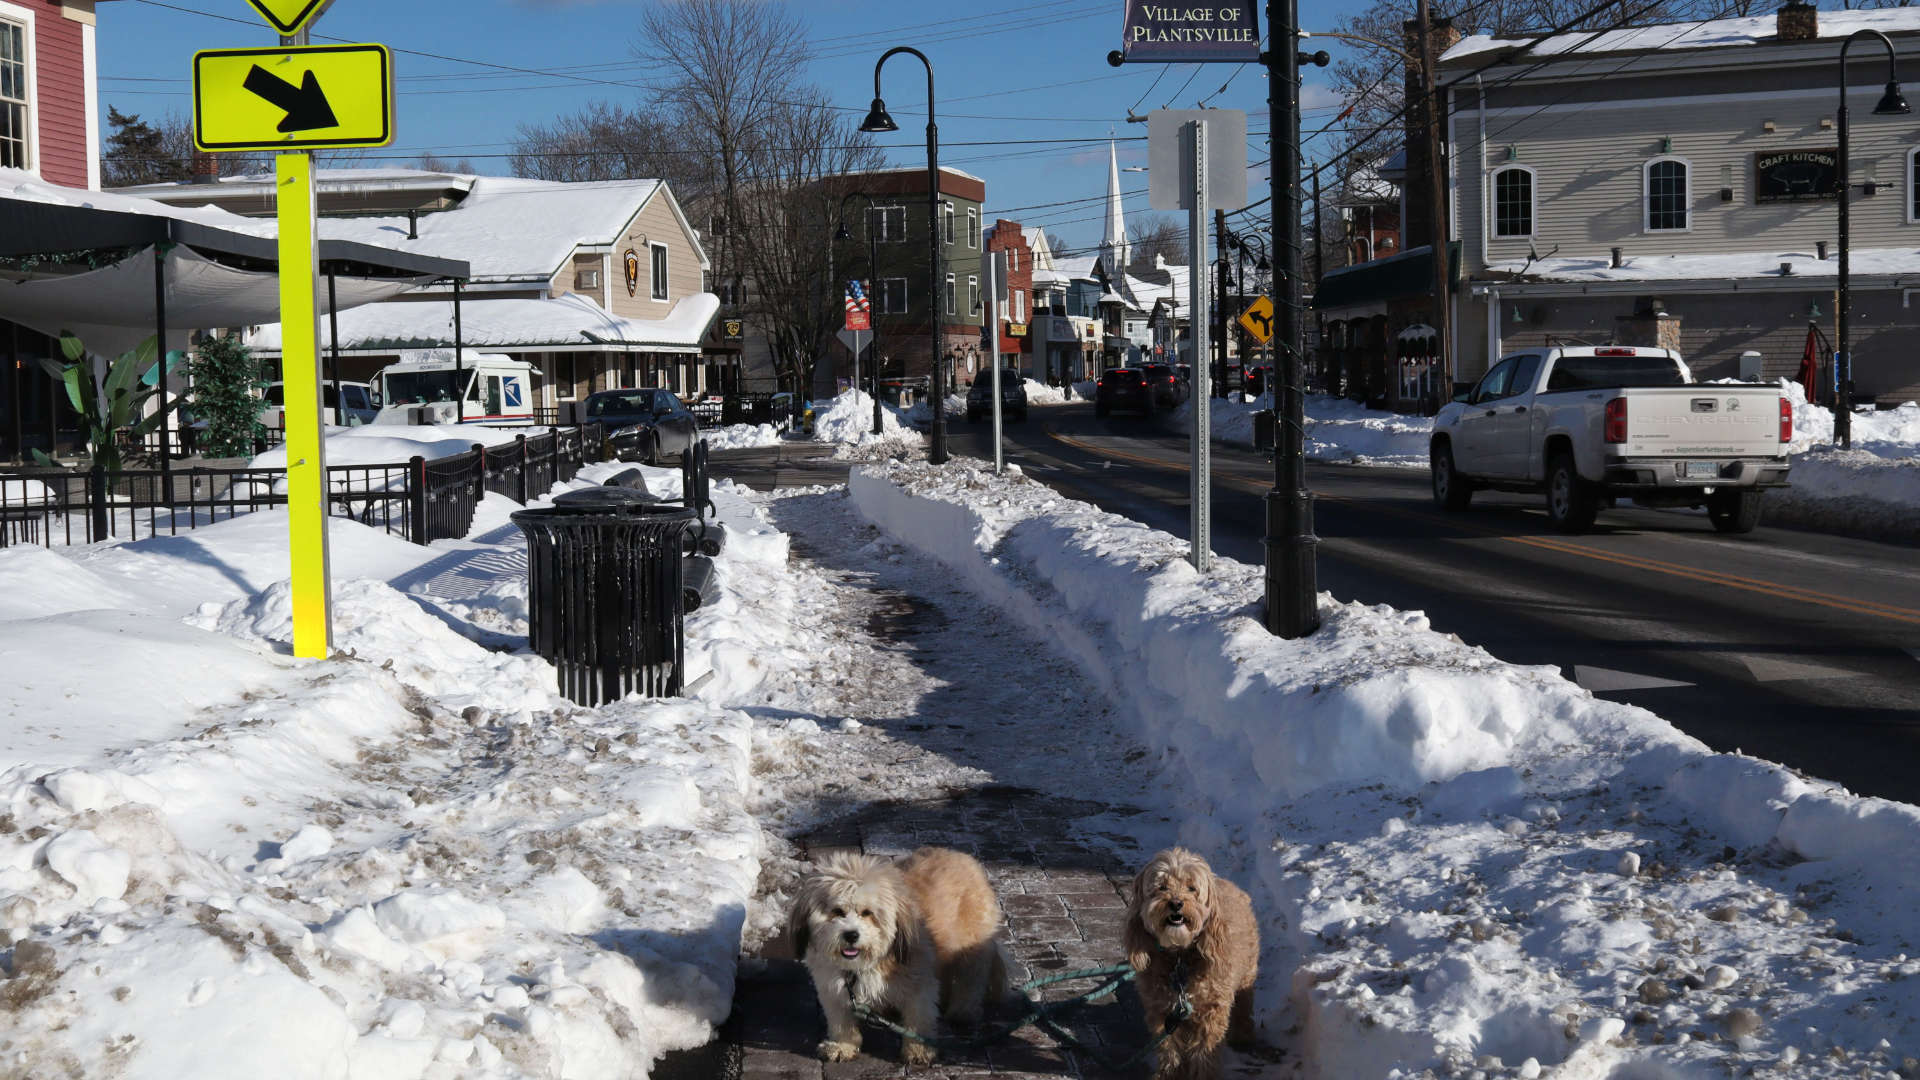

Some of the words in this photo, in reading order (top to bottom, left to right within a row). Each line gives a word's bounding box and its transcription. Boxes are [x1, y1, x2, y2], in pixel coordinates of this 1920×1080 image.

[1142, 5, 1213, 21] VILLAGE
[1132, 26, 1253, 42] PLANTSVILLE
[1759, 154, 1790, 169] CRAFT
[1792, 152, 1836, 167] KITCHEN
[1635, 415, 1769, 425] CHEVROLET
